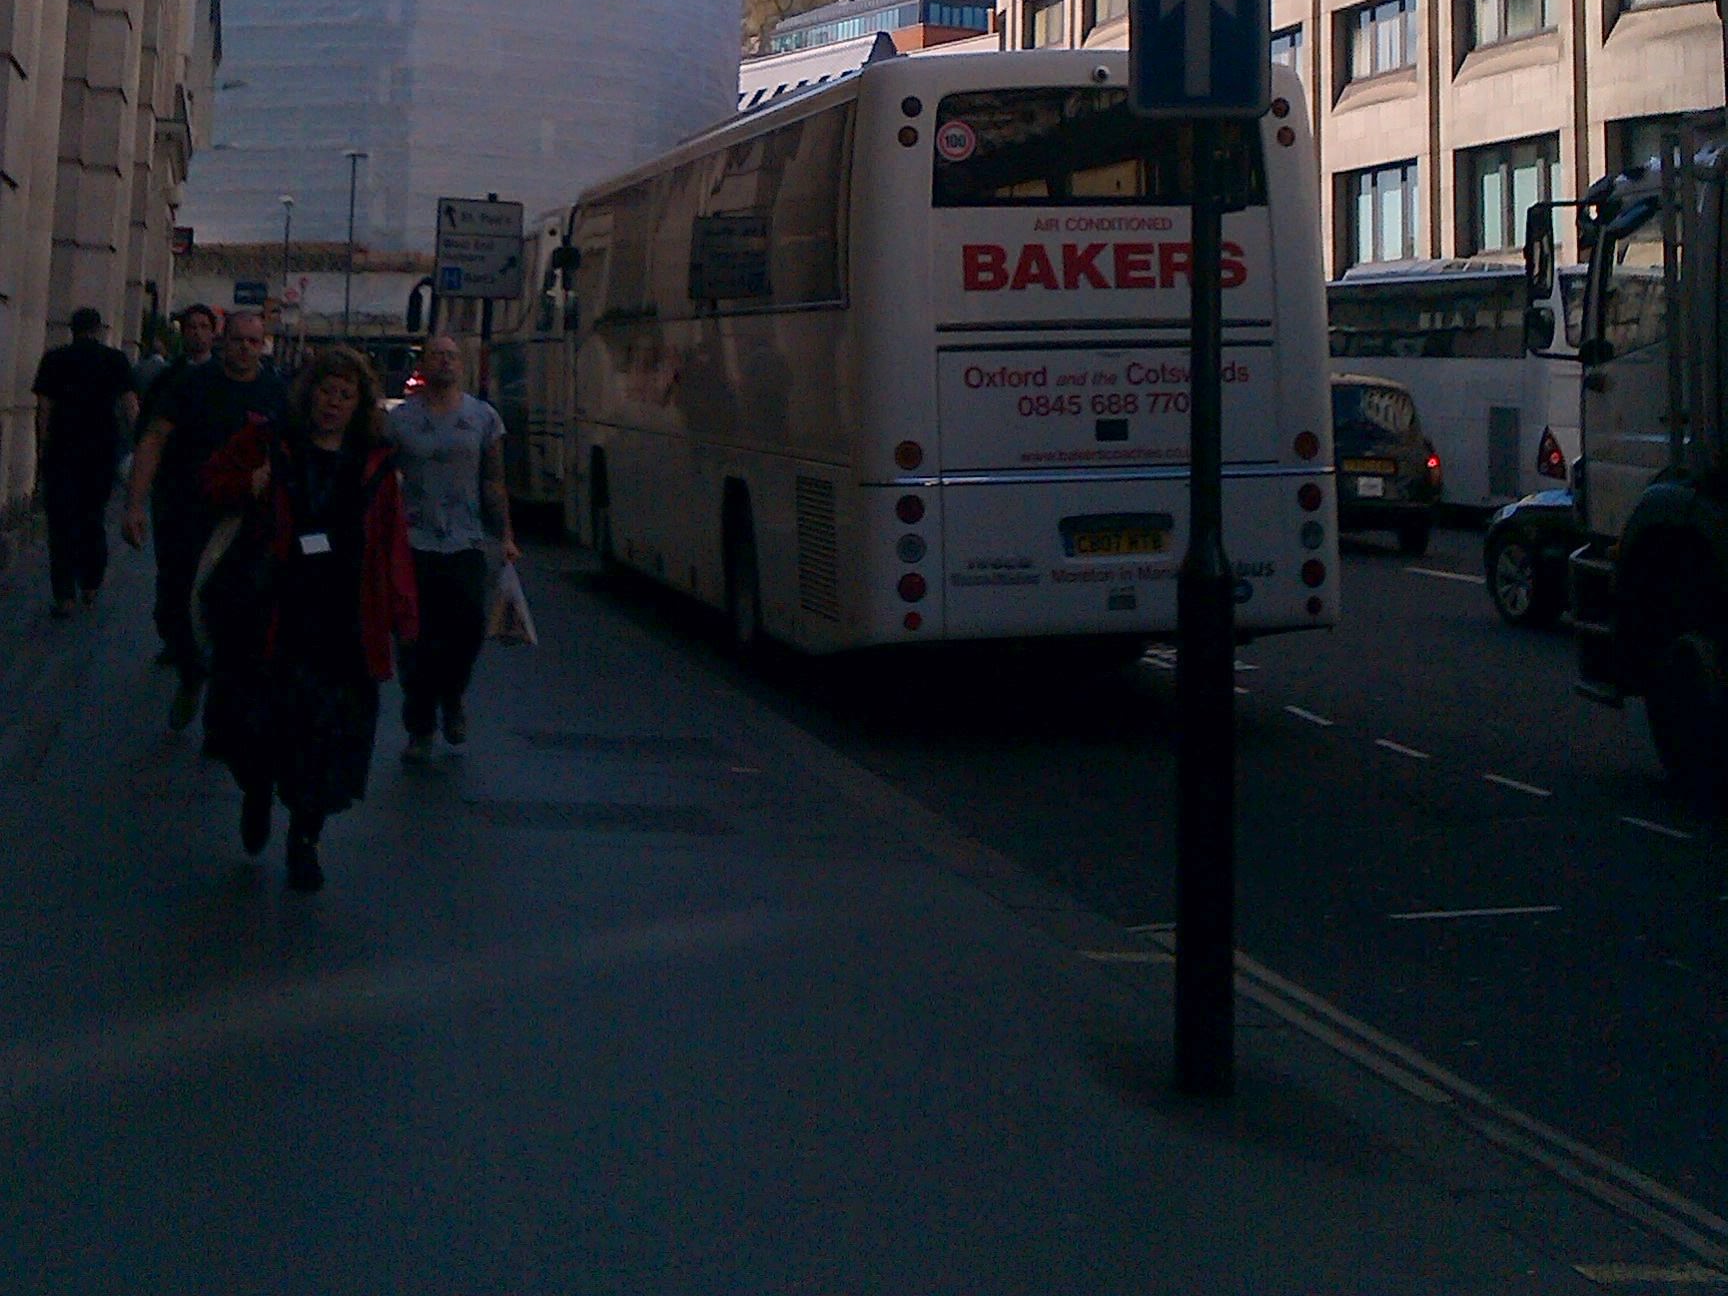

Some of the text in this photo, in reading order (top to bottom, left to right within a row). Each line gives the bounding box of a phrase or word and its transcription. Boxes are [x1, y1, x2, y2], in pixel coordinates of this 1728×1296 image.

[945, 134, 967, 148] 100
[1034, 216, 1173, 232] AIR CONDITIONED
[962, 241, 1249, 292] BAKERS
[963, 365, 1048, 390] Oxford
[1055, 369, 1088, 386] and
[1091, 367, 1118, 385] the
[1017, 394, 1083, 417] 0845
[1090, 393, 1139, 415] 688
